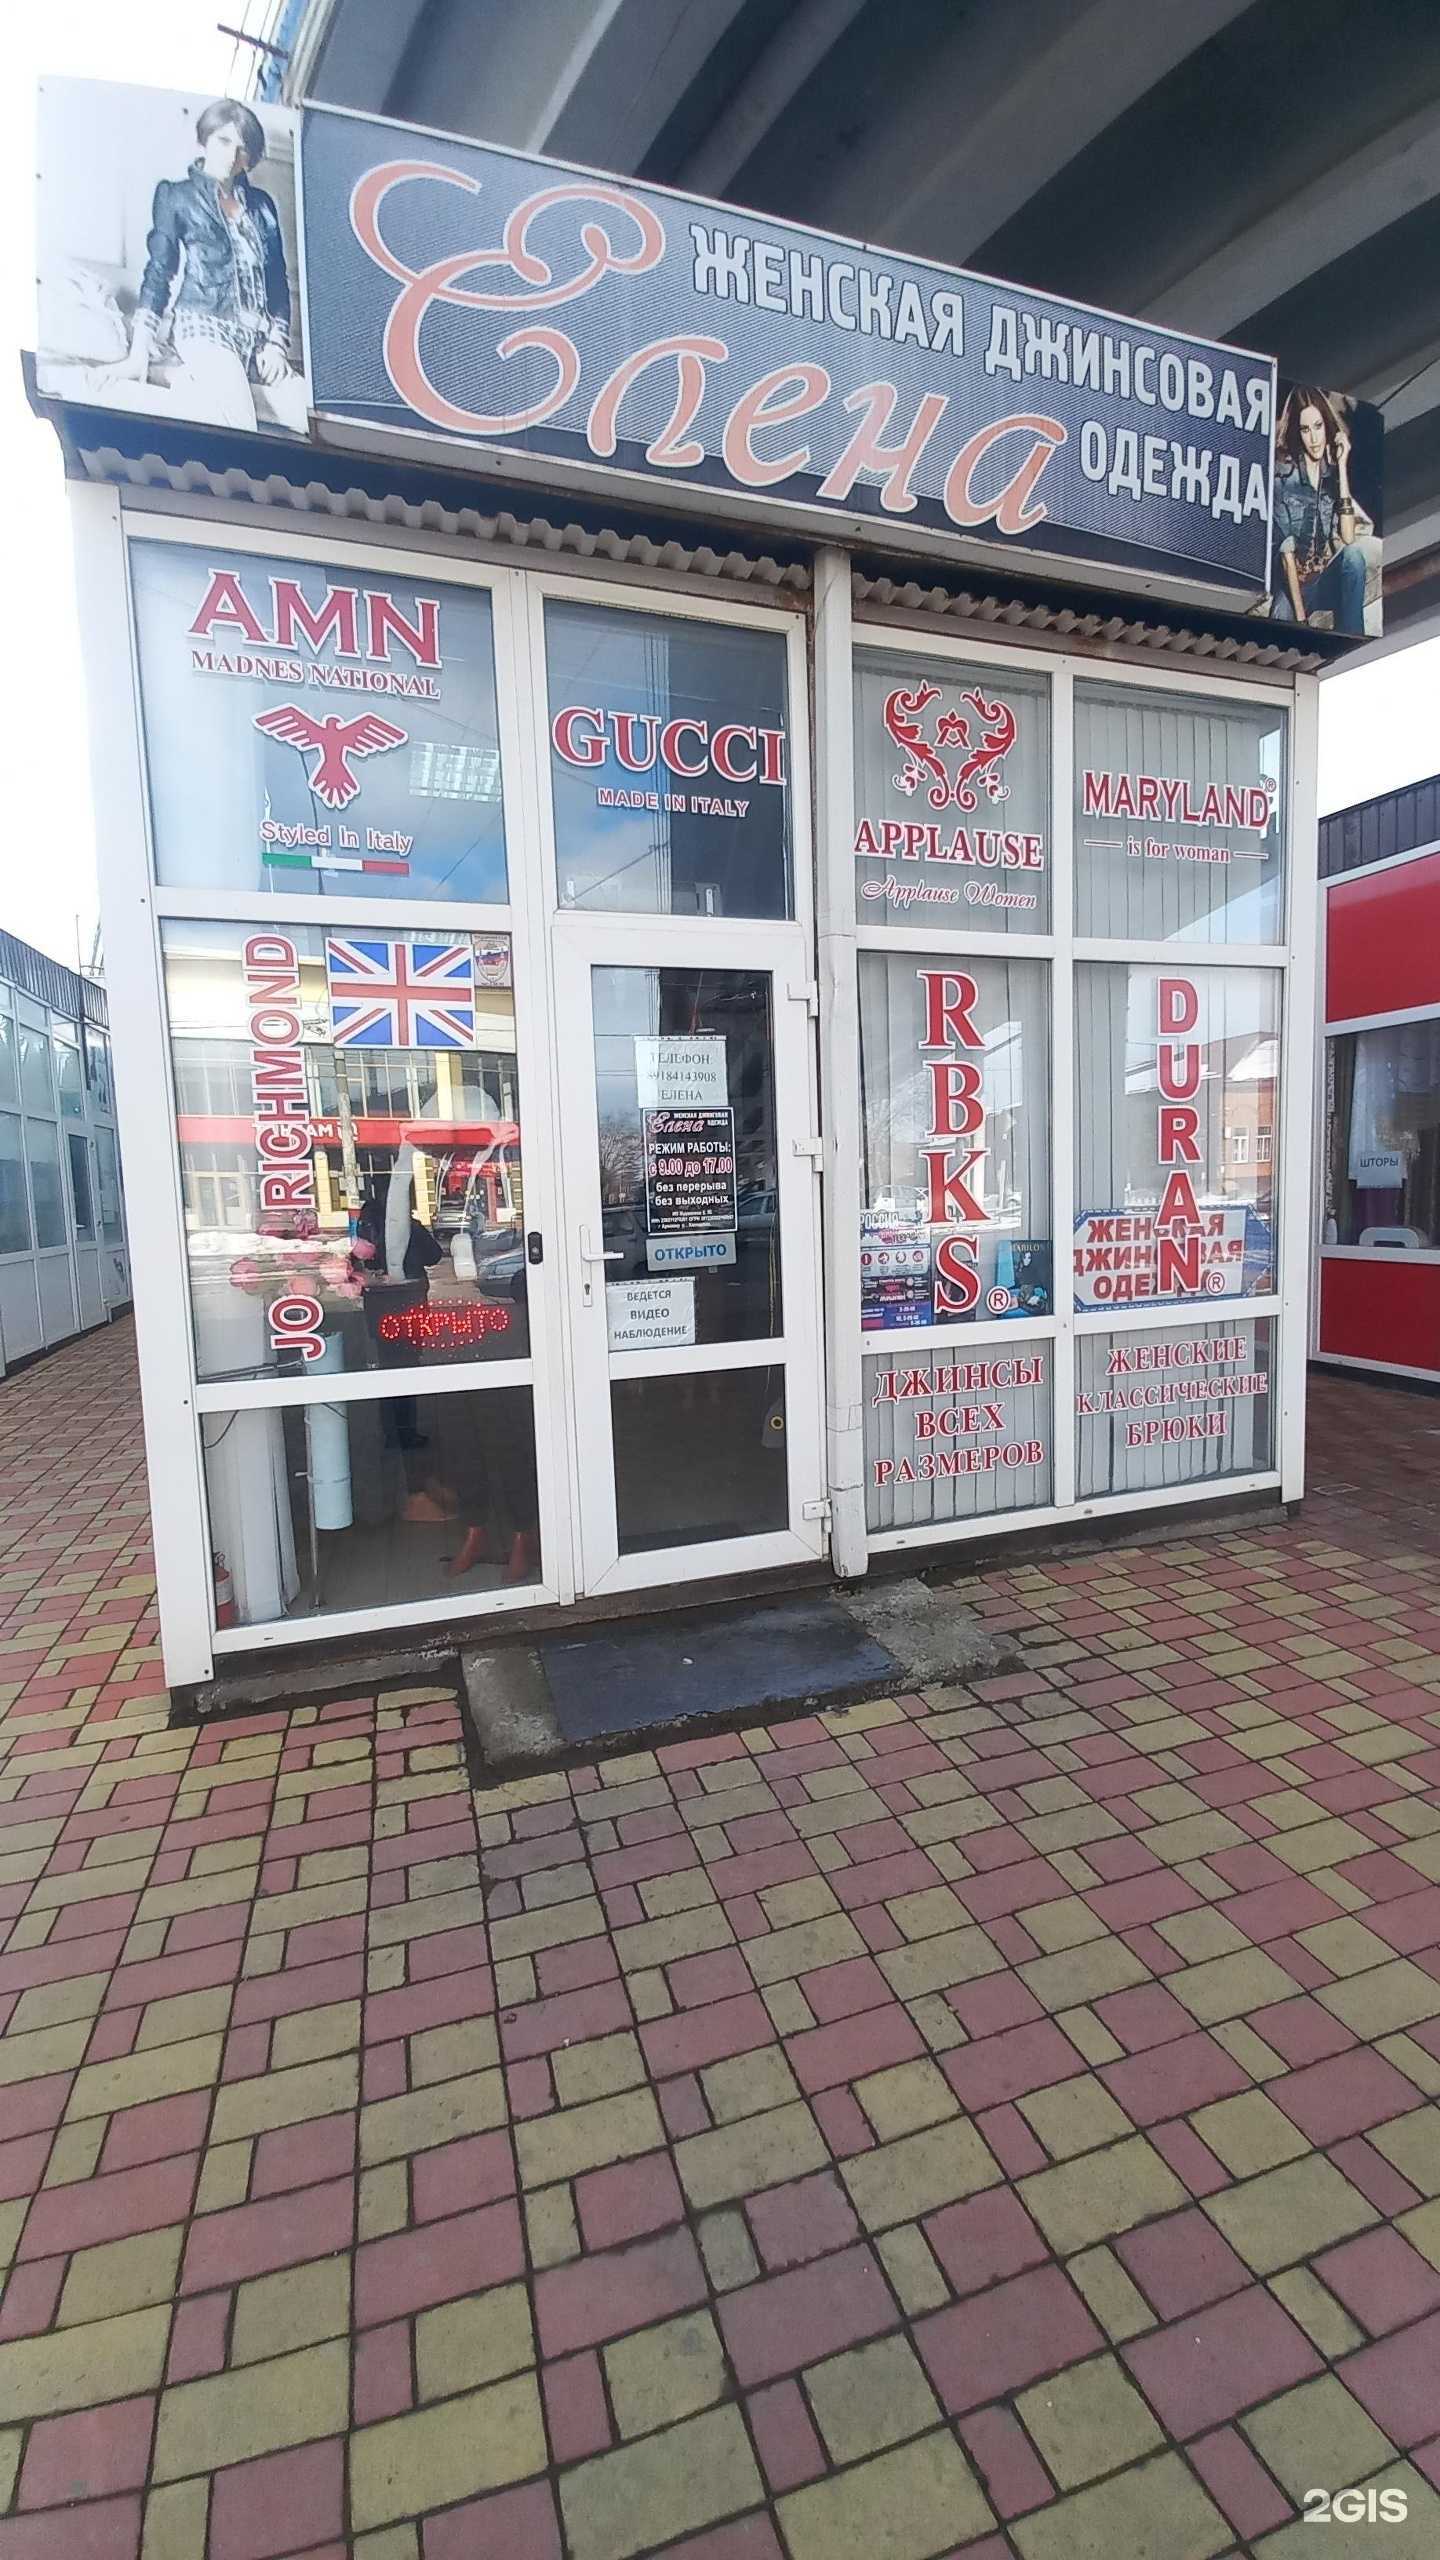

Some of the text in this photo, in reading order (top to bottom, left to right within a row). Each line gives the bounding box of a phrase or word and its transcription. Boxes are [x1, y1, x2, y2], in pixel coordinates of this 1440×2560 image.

[350, 159, 1066, 535] Елена
[689, 223, 1272, 437] ЖЕНСКАЯ ДЖИНСОВАЯ
[1078, 419, 1268, 523] ОДЕЖДА
[187, 568, 443, 669] AMN
[191, 649, 441, 700] MADNES NATIONAL
[552, 706, 787, 787] GUCCI
[598, 787, 749, 818] MADE IN ITALY
[1082, 770, 1270, 830] MARYLAND
[260, 820, 414, 857] Styled In Italy
[854, 818, 1045, 871] APPLAUSE
[1127, 836, 1231, 865] is for woman
[861, 875, 1037, 909] Applause Women
[242, 932, 316, 1212] RICHMOND
[661, 1089, 704, 1101] ЕЛЕНА
[648, 1142, 731, 1154] РЕЖИМ РАБОТЫ:
[1359, 1157, 1399, 1169] ШТОРЫ
[656, 1182, 727, 1193] без перерыва
[684, 1161, 701, 1177] до
[655, 1195, 729, 1206] без выходных
[655, 1244, 727, 1261] ОТКРЫТО
[626, 1289, 671, 1302] ВЕДЕТСЯ
[630, 1308, 669, 1320] ВИДЕО
[381, 1309, 508, 1339] ОТКРЫТО
[614, 1326, 687, 1340] НАБЛЮДЕНИЕ
[1105, 1336, 1249, 1377] ЖЕНСКИЕ
[873, 1356, 1043, 1407] ДЖИНСЫ
[1077, 1371, 1268, 1415] КЛАССИЧЕСКИЕ
[915, 1402, 1005, 1441] ВСЕХ
[1125, 1411, 1227, 1448] БРЮКИ
[875, 1440, 1044, 1487] РАЗМЕРОВ
